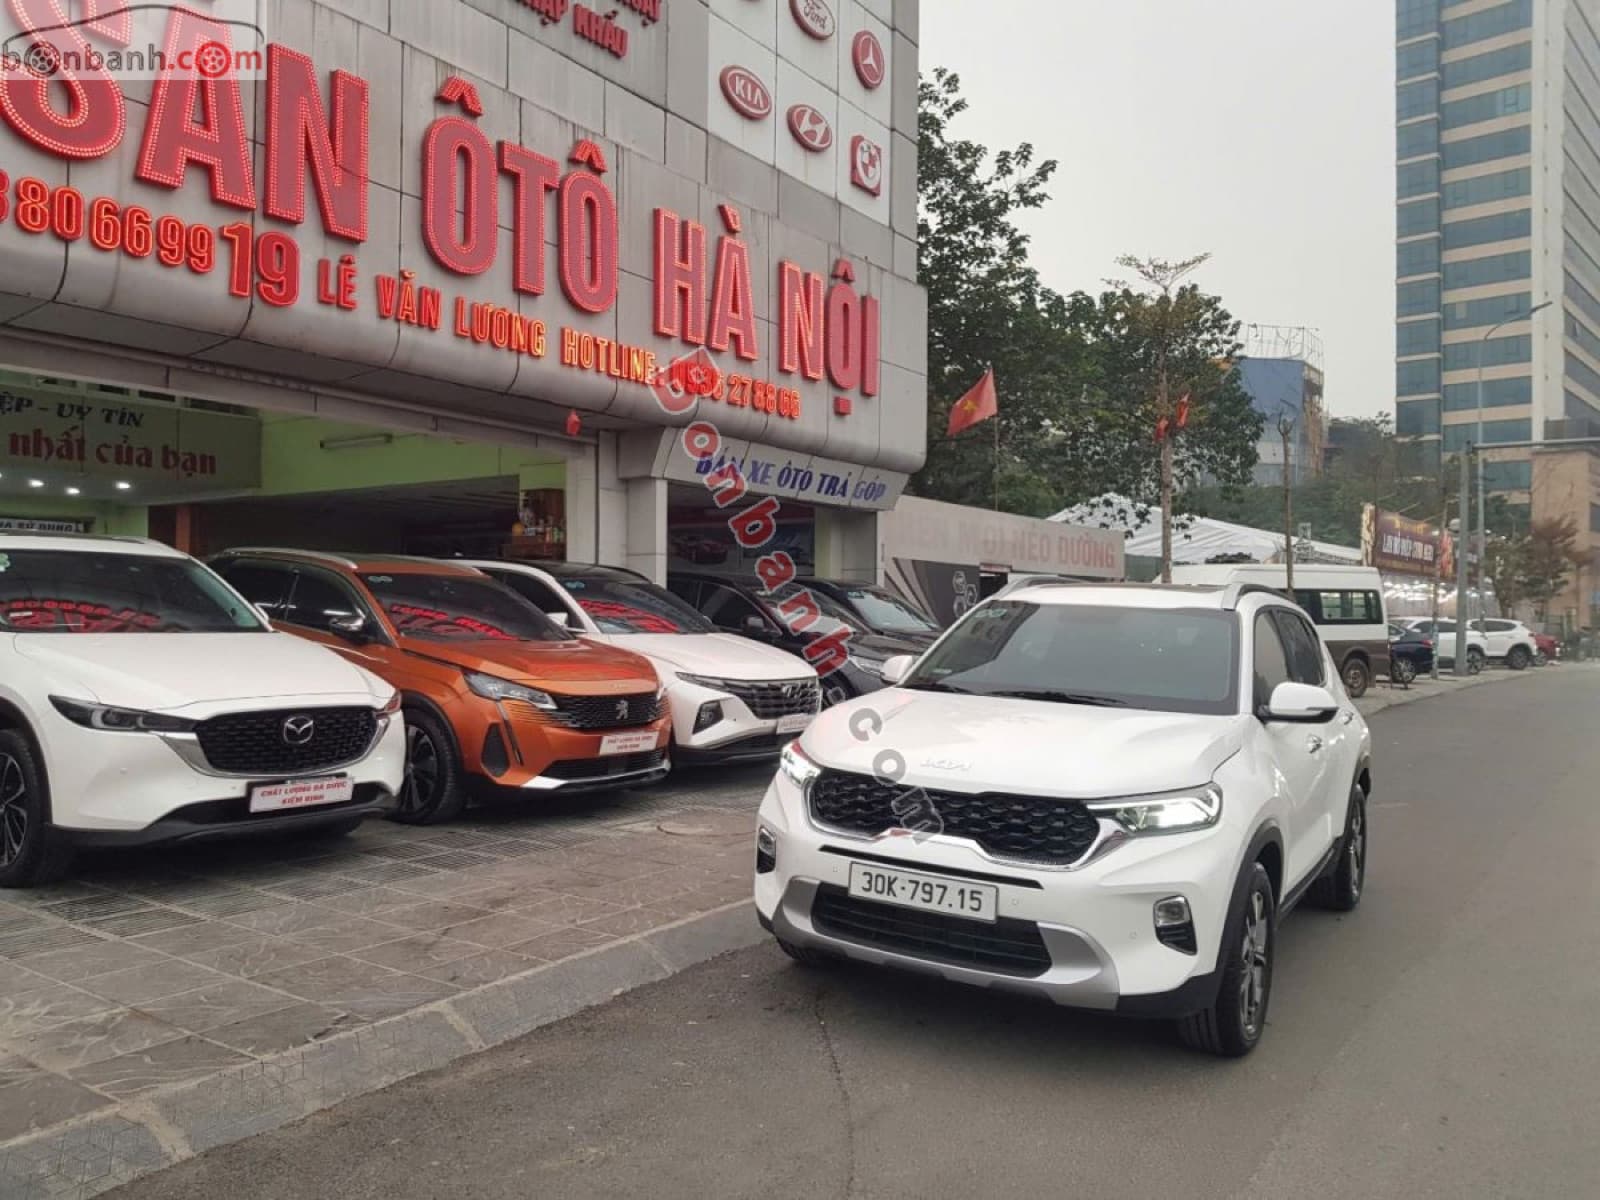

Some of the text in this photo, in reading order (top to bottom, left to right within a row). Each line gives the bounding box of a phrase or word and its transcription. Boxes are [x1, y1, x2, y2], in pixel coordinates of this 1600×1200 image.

[735, 75, 765, 109] KIA
[221, 222, 300, 308] 19
[317, 254, 358, 311] LÊ
[375, 268, 441, 330] VĂN
[454, 296, 547, 357] LƯƠNG
[653, 203, 758, 361] HÀ
[777, 258, 880, 416] NỘI
[102, 406, 145, 427] TÍN
[8, 425, 217, 477] nhất của bạn
[746, 460, 776, 485] XE
[776, 460, 814, 492] ÔTÔ
[816, 471, 853, 497] TRẢ
[853, 474, 888, 502] GÓP
